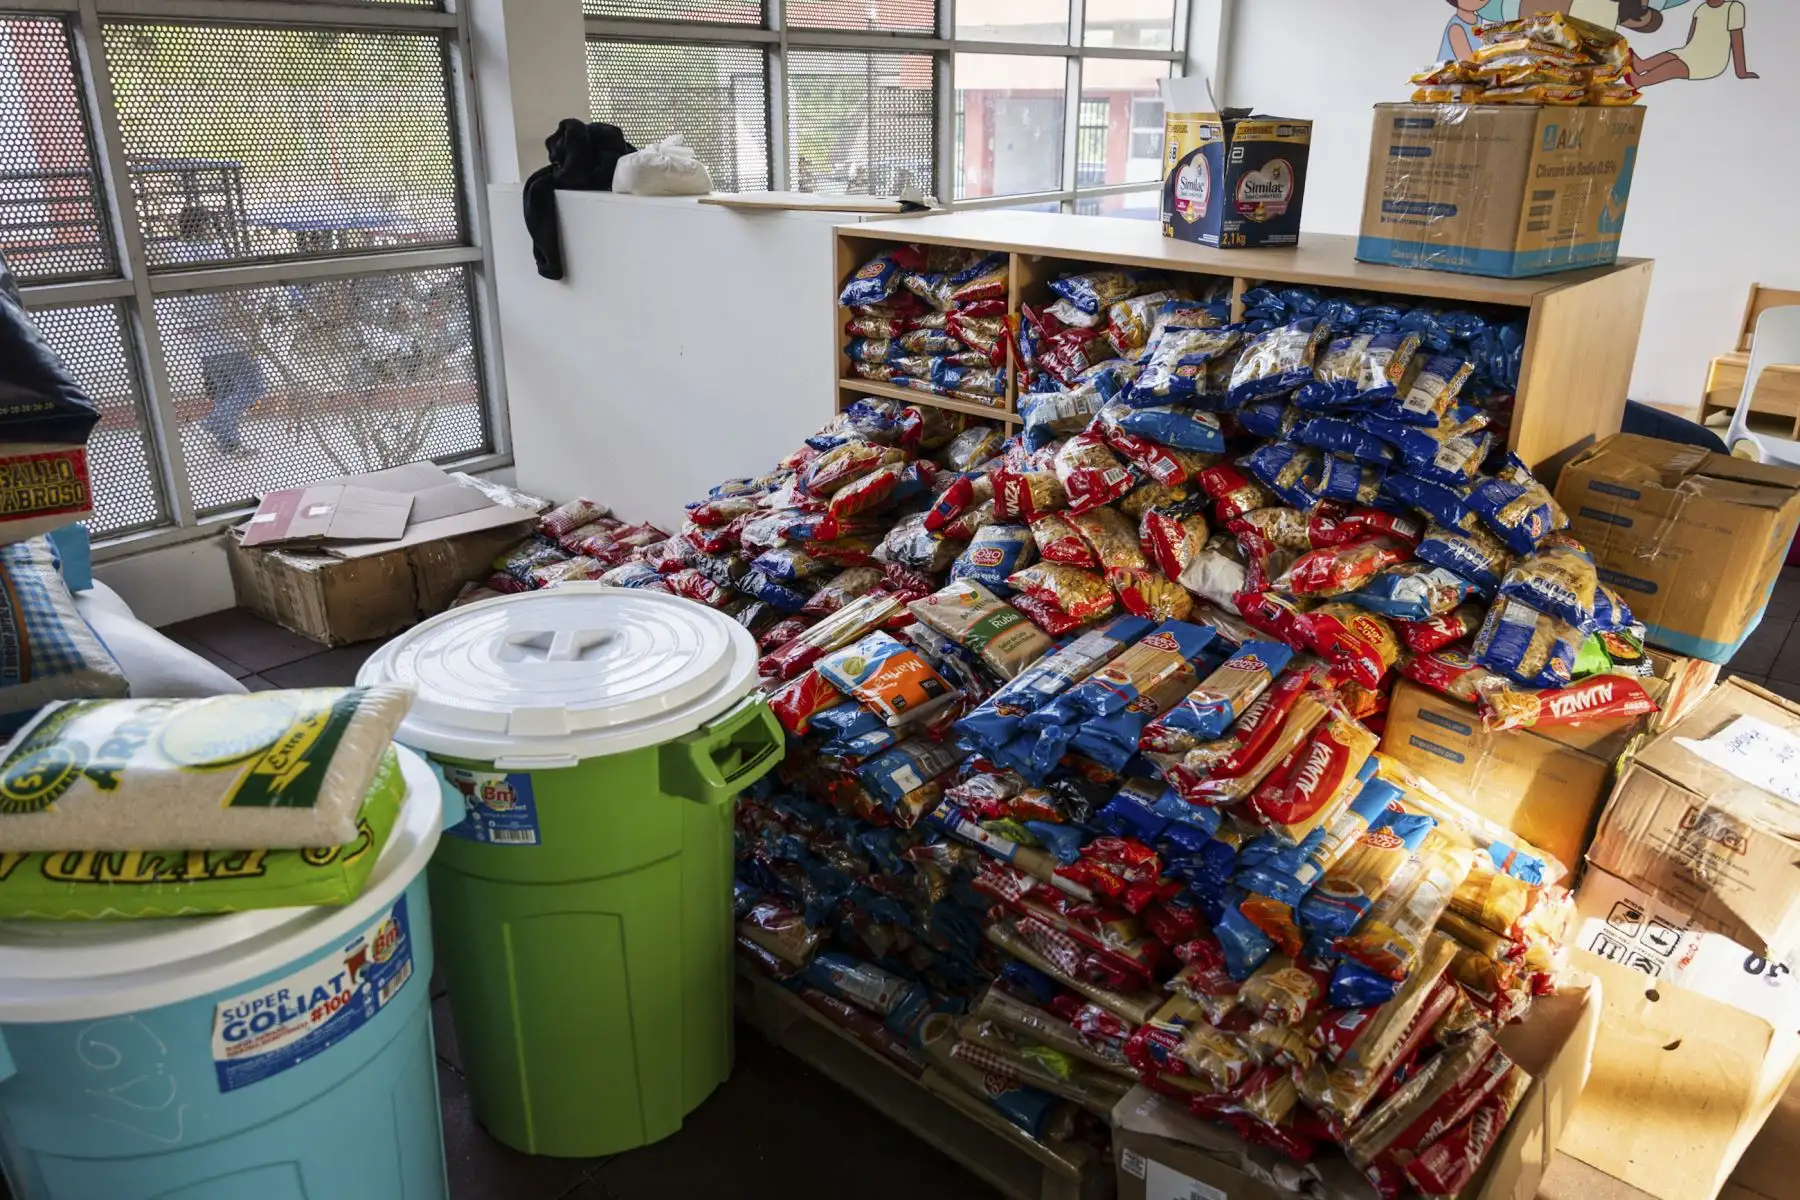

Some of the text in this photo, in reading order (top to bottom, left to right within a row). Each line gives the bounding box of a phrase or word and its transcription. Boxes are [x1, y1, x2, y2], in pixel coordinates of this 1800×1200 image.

[1566, 163, 1575, 176] de
[1180, 176, 1204, 193] Similac
[1244, 180, 1284, 194] Similac
[1222, 232, 1235, 245] 2,1
[1236, 233, 1246, 246] kg
[0, 483, 85, 512] ABROSO
[992, 612, 1018, 629] Rubia
[1353, 615, 1384, 641] Espiga
[1550, 683, 1613, 717] ALIANZA
[267, 727, 307, 771] Extra
[1296, 740, 1334, 797] ALIANZA
[485, 786, 514, 802] Bm
[222, 987, 291, 1024] SÚPER
[222, 971, 347, 1042] GOLIAT
[310, 989, 352, 1023] #100
